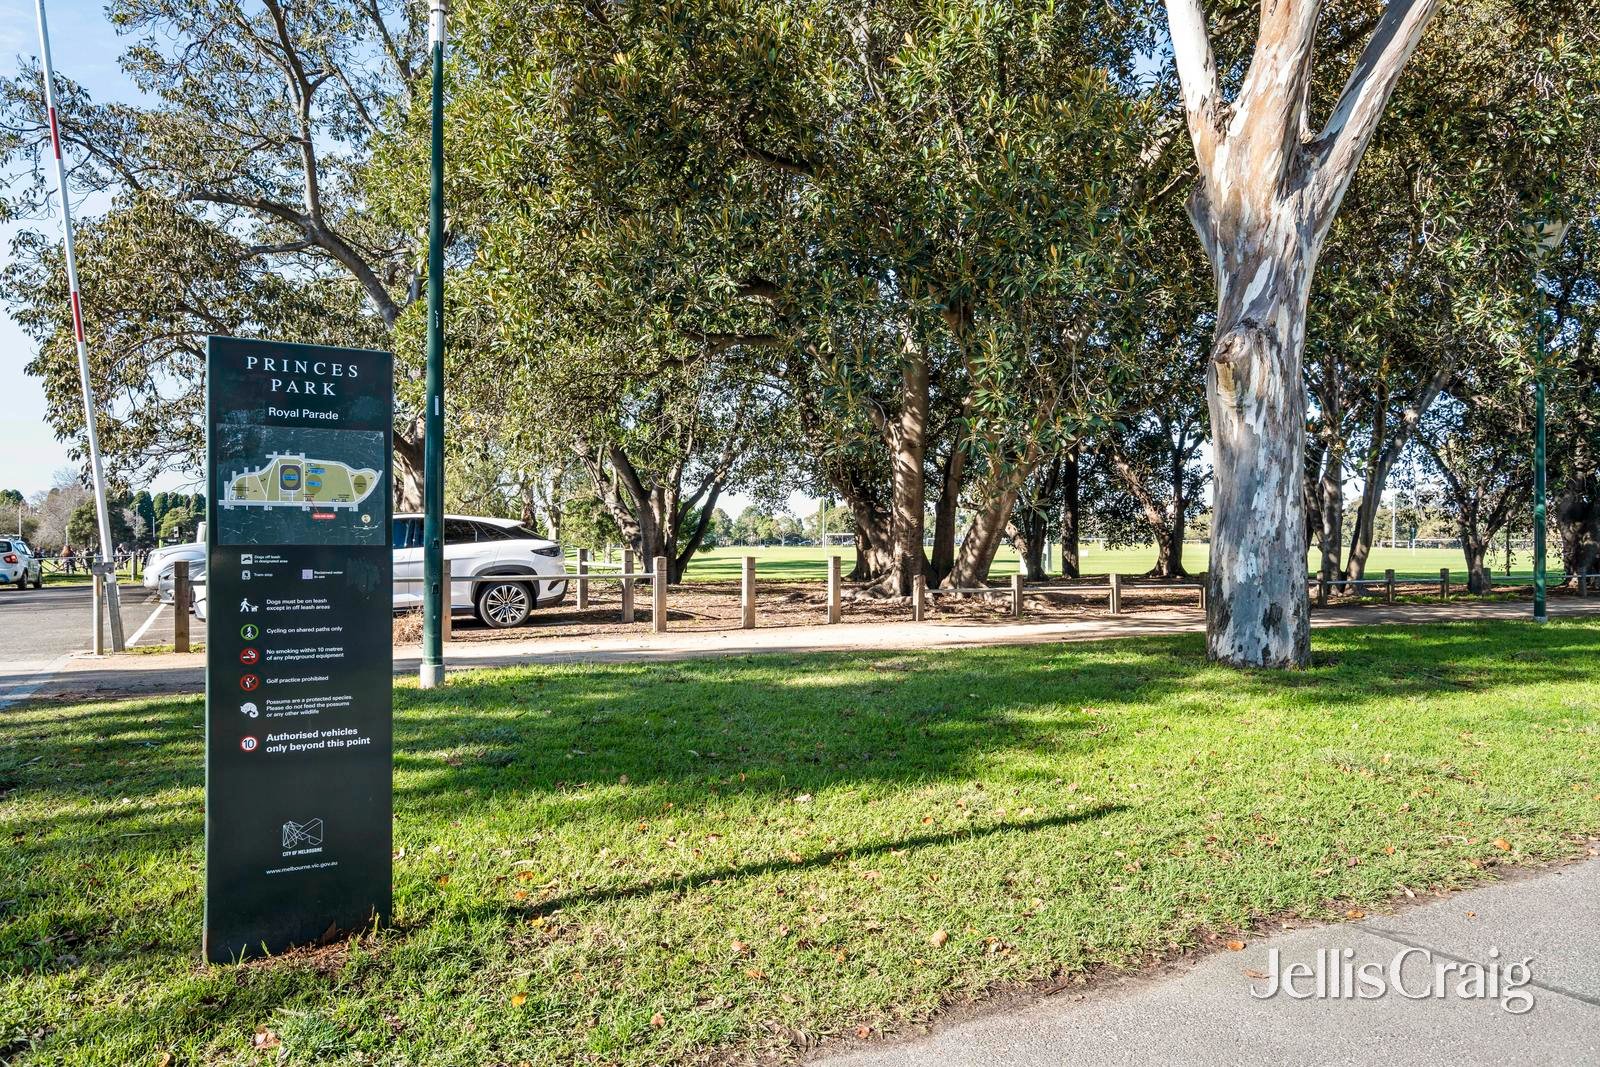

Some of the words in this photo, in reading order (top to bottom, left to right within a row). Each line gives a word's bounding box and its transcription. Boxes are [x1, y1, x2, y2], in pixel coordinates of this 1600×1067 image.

[246, 356, 358, 378] PRINCES
[272, 379, 336, 396] PARK
[268, 407, 298, 418] Royal
[302, 408, 338, 420] Parade
[266, 730, 319, 742] Authorised
[321, 728, 358, 737] vehicles
[244, 739, 254, 748] 10
[266, 744, 287, 753] only
[290, 741, 324, 752] beyond
[327, 739, 344, 748] this
[346, 737, 370, 748] point
[298, 847, 322, 855] MELBOURNE
[266, 861, 338, 875] www.melbourne.vic.gov.au
